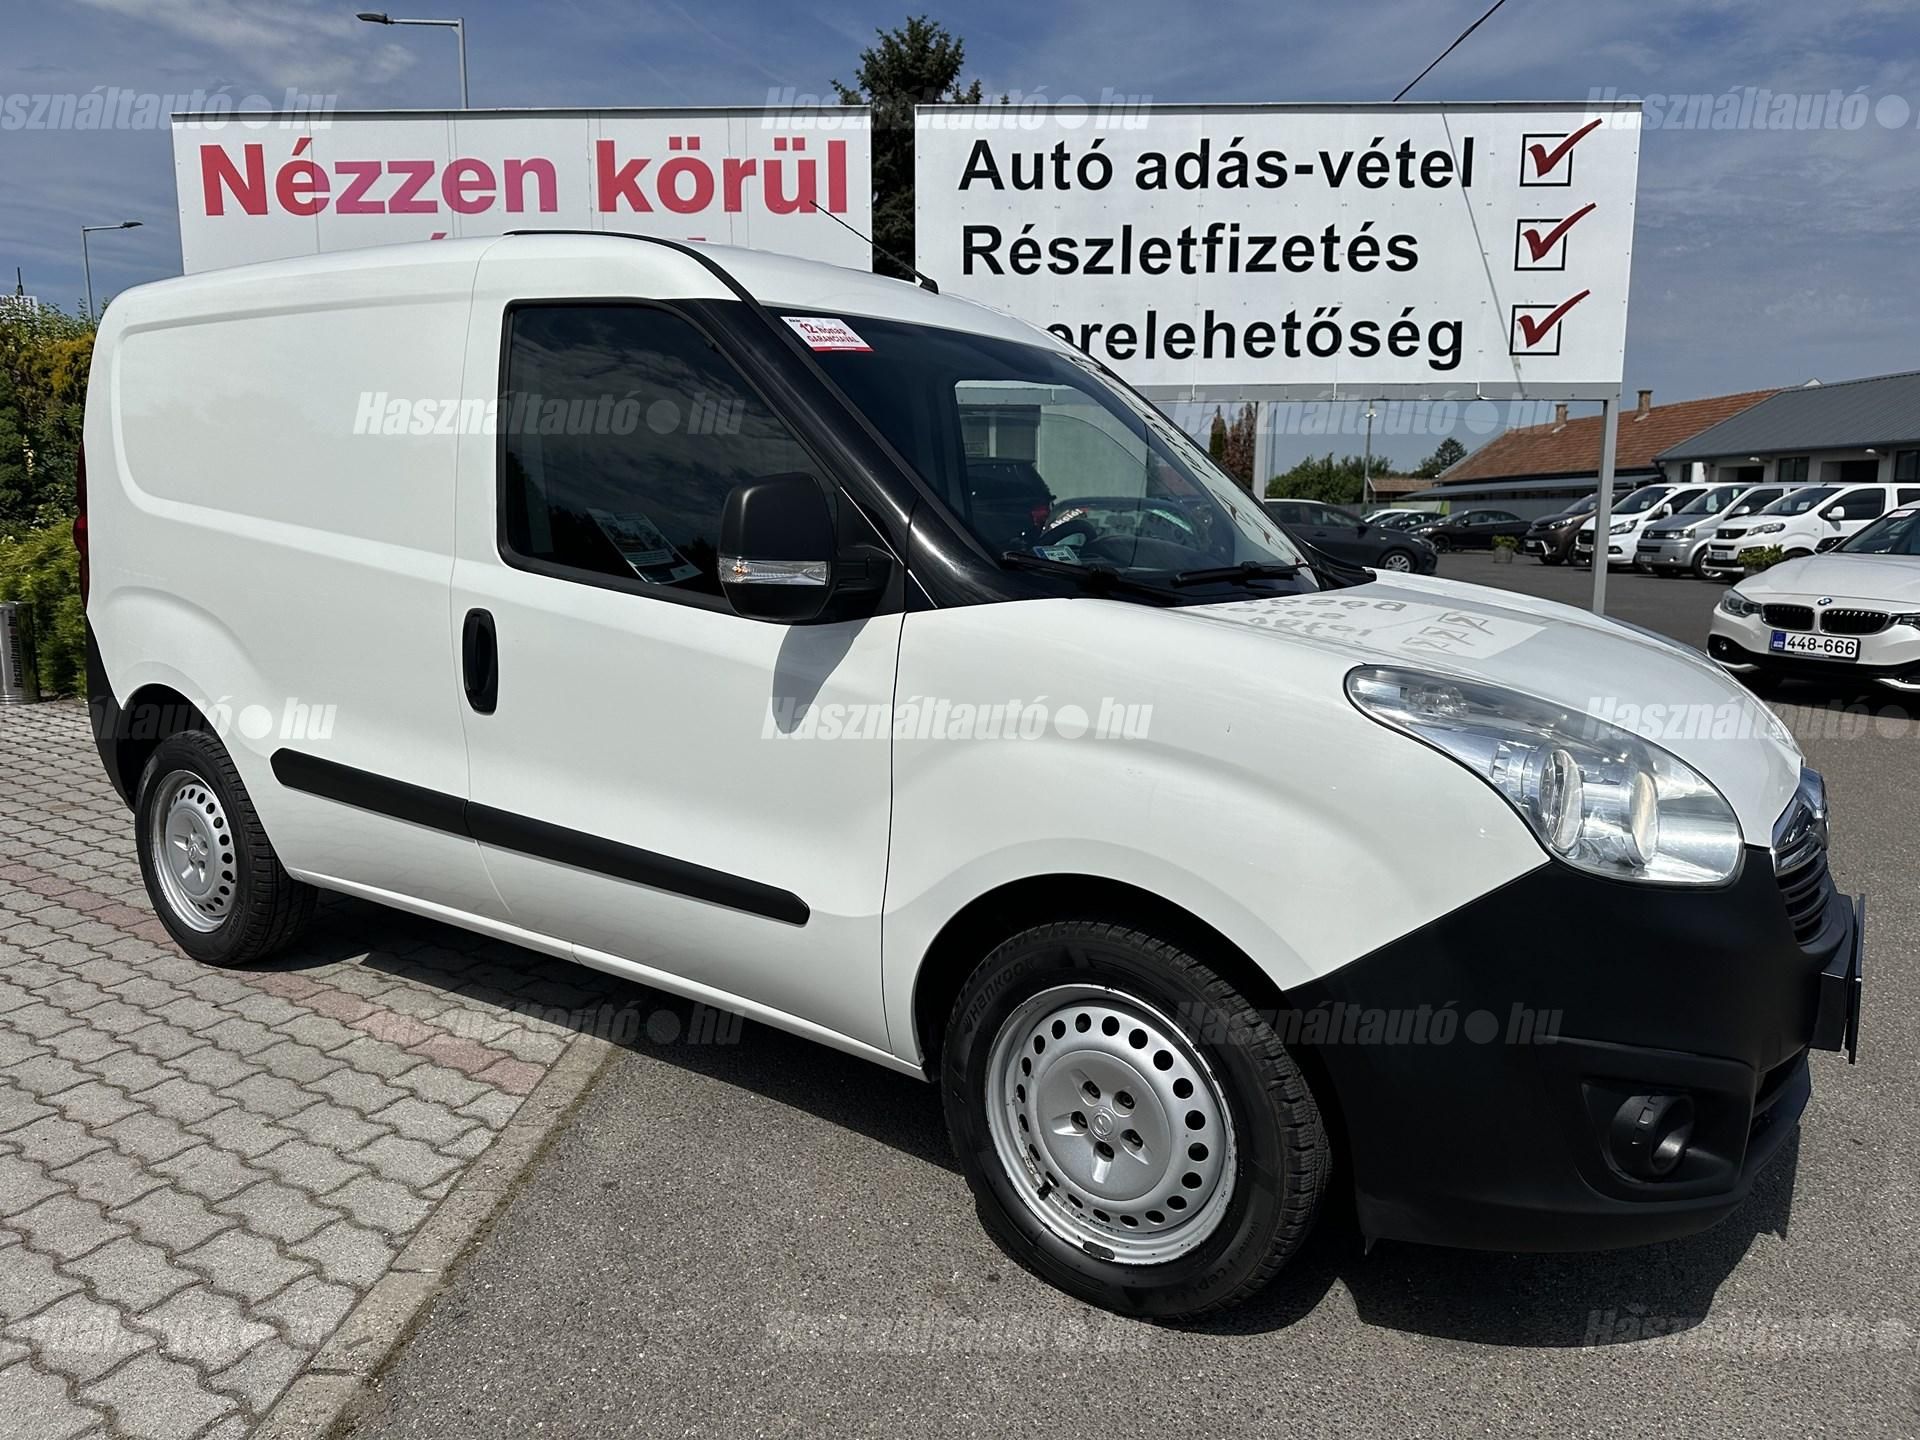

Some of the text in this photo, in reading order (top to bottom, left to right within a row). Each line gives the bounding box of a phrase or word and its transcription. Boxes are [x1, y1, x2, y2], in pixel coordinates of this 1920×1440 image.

[201, 136, 848, 216] Nézzen körül
[958, 136, 1474, 191] Autó adás-vétel
[963, 222, 1419, 276] Részletfizetés
[1787, 635, 1855, 655] 448-666
